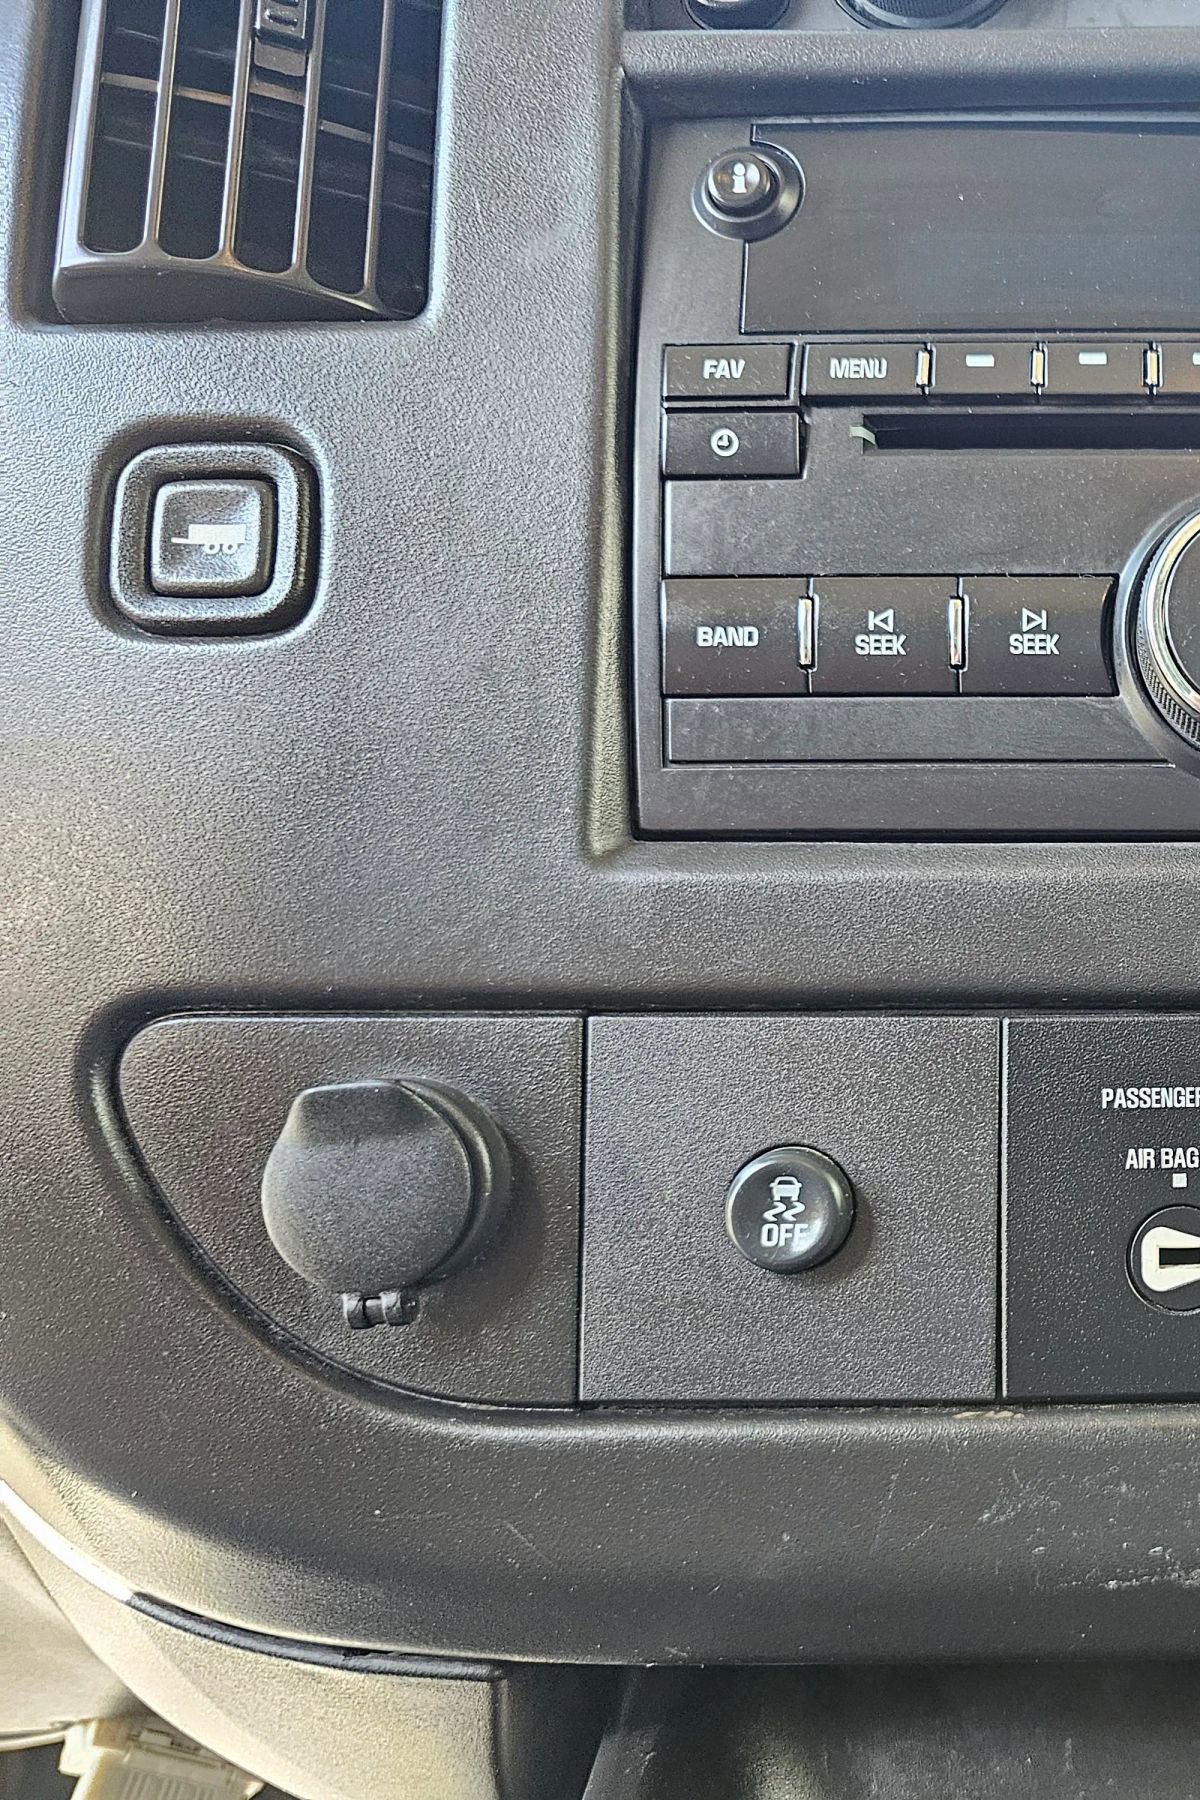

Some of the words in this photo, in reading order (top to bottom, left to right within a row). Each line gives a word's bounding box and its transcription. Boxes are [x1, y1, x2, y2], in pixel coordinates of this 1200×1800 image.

[702, 358, 746, 381] FAV
[829, 357, 888, 380] MENU
[696, 625, 760, 648] BAND
[855, 633, 907, 657] SEEK
[1008, 633, 1060, 657] SEEK
[1125, 1148, 1156, 1170] AIR
[1160, 1147, 1200, 1170] BAG
[760, 1223, 809, 1248] OFF
